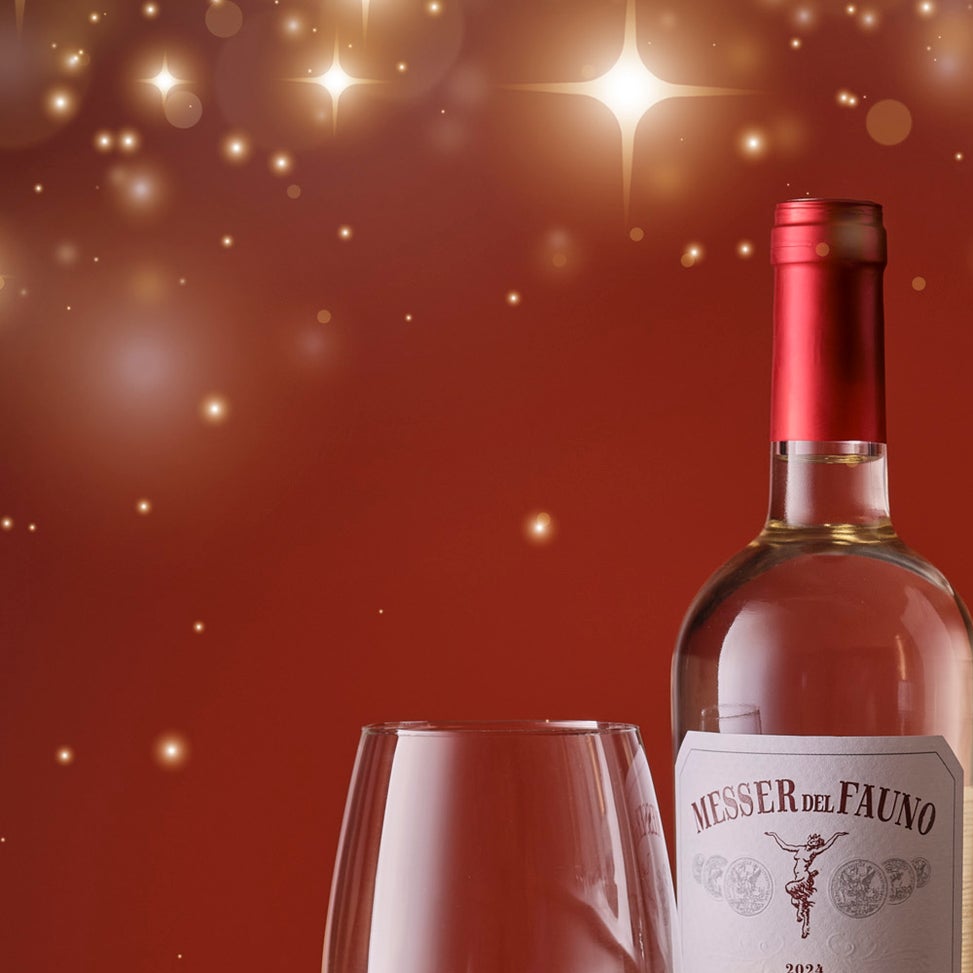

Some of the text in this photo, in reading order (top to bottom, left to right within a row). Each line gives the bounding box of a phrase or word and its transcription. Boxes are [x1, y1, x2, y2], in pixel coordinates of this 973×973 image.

[690, 778, 798, 834] MESSER
[801, 793, 835, 814] DEL
[836, 780, 936, 836] FAUNO
